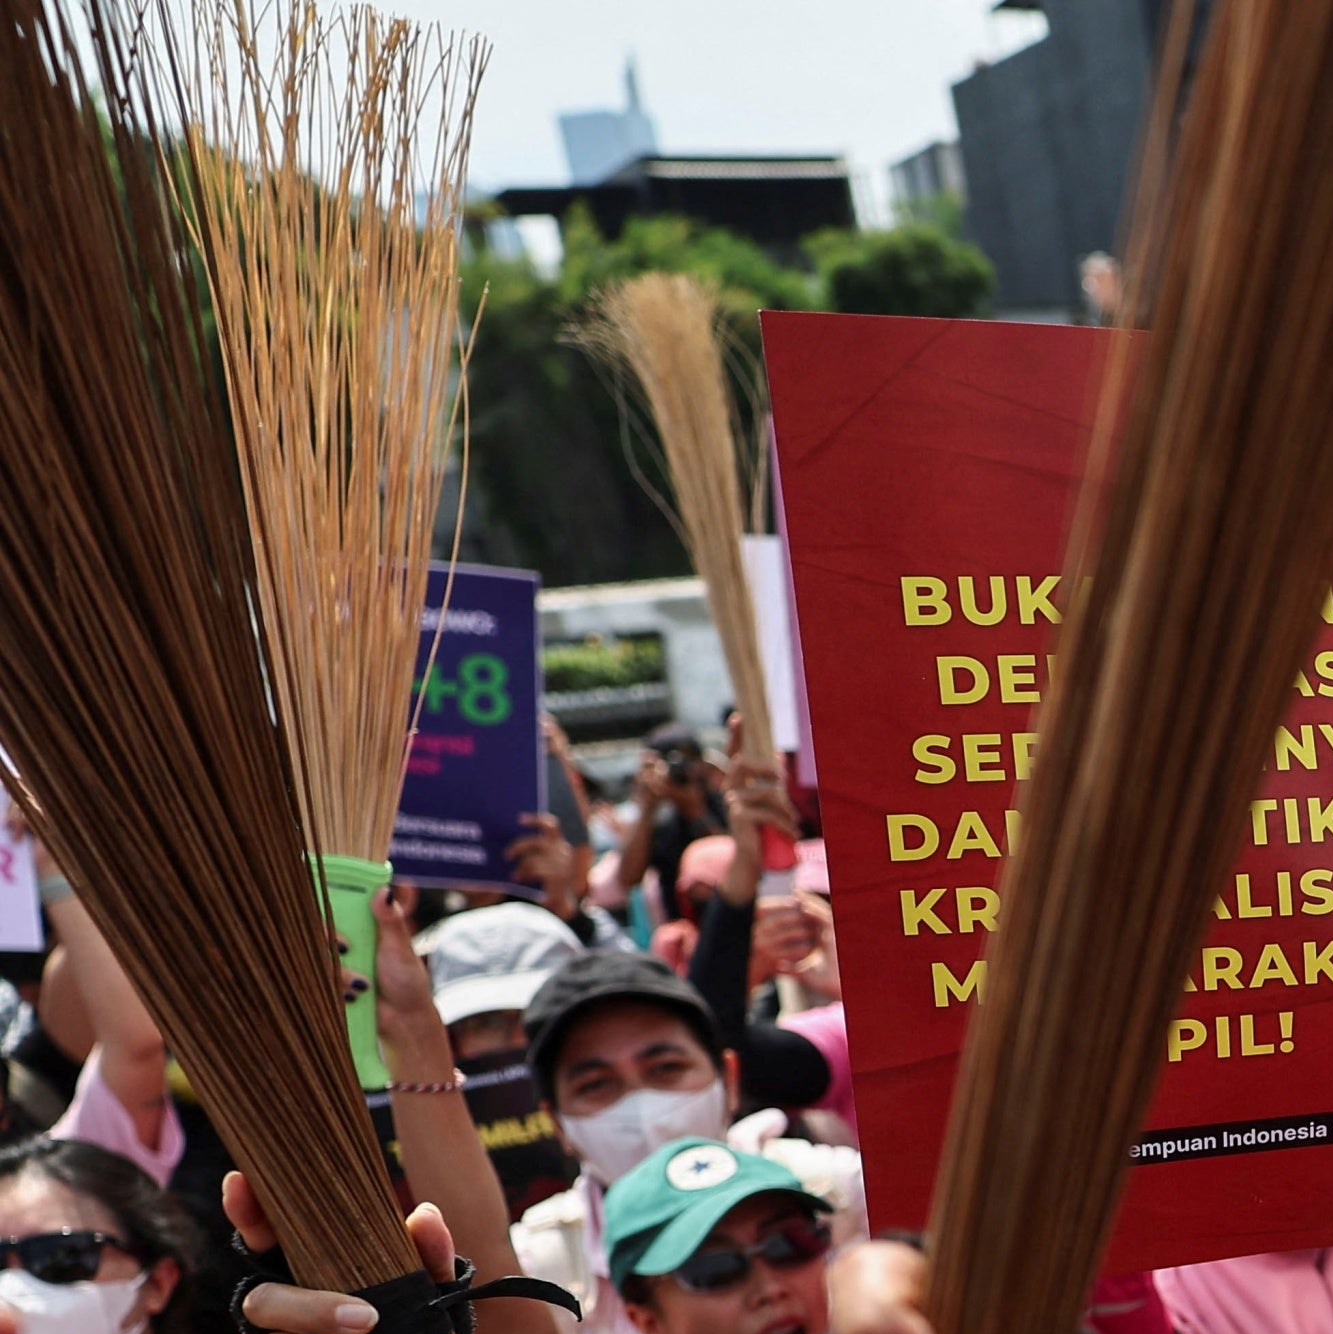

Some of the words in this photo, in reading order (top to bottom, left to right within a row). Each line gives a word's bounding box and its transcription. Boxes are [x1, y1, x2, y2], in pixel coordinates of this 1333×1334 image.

[900, 575, 1094, 627] BUK
[411, 652, 512, 726] +8
[1167, 1012, 1296, 1064] PIL!
[1128, 1133, 1217, 1160] empuan
[1222, 1121, 1328, 1148] Indonesia
